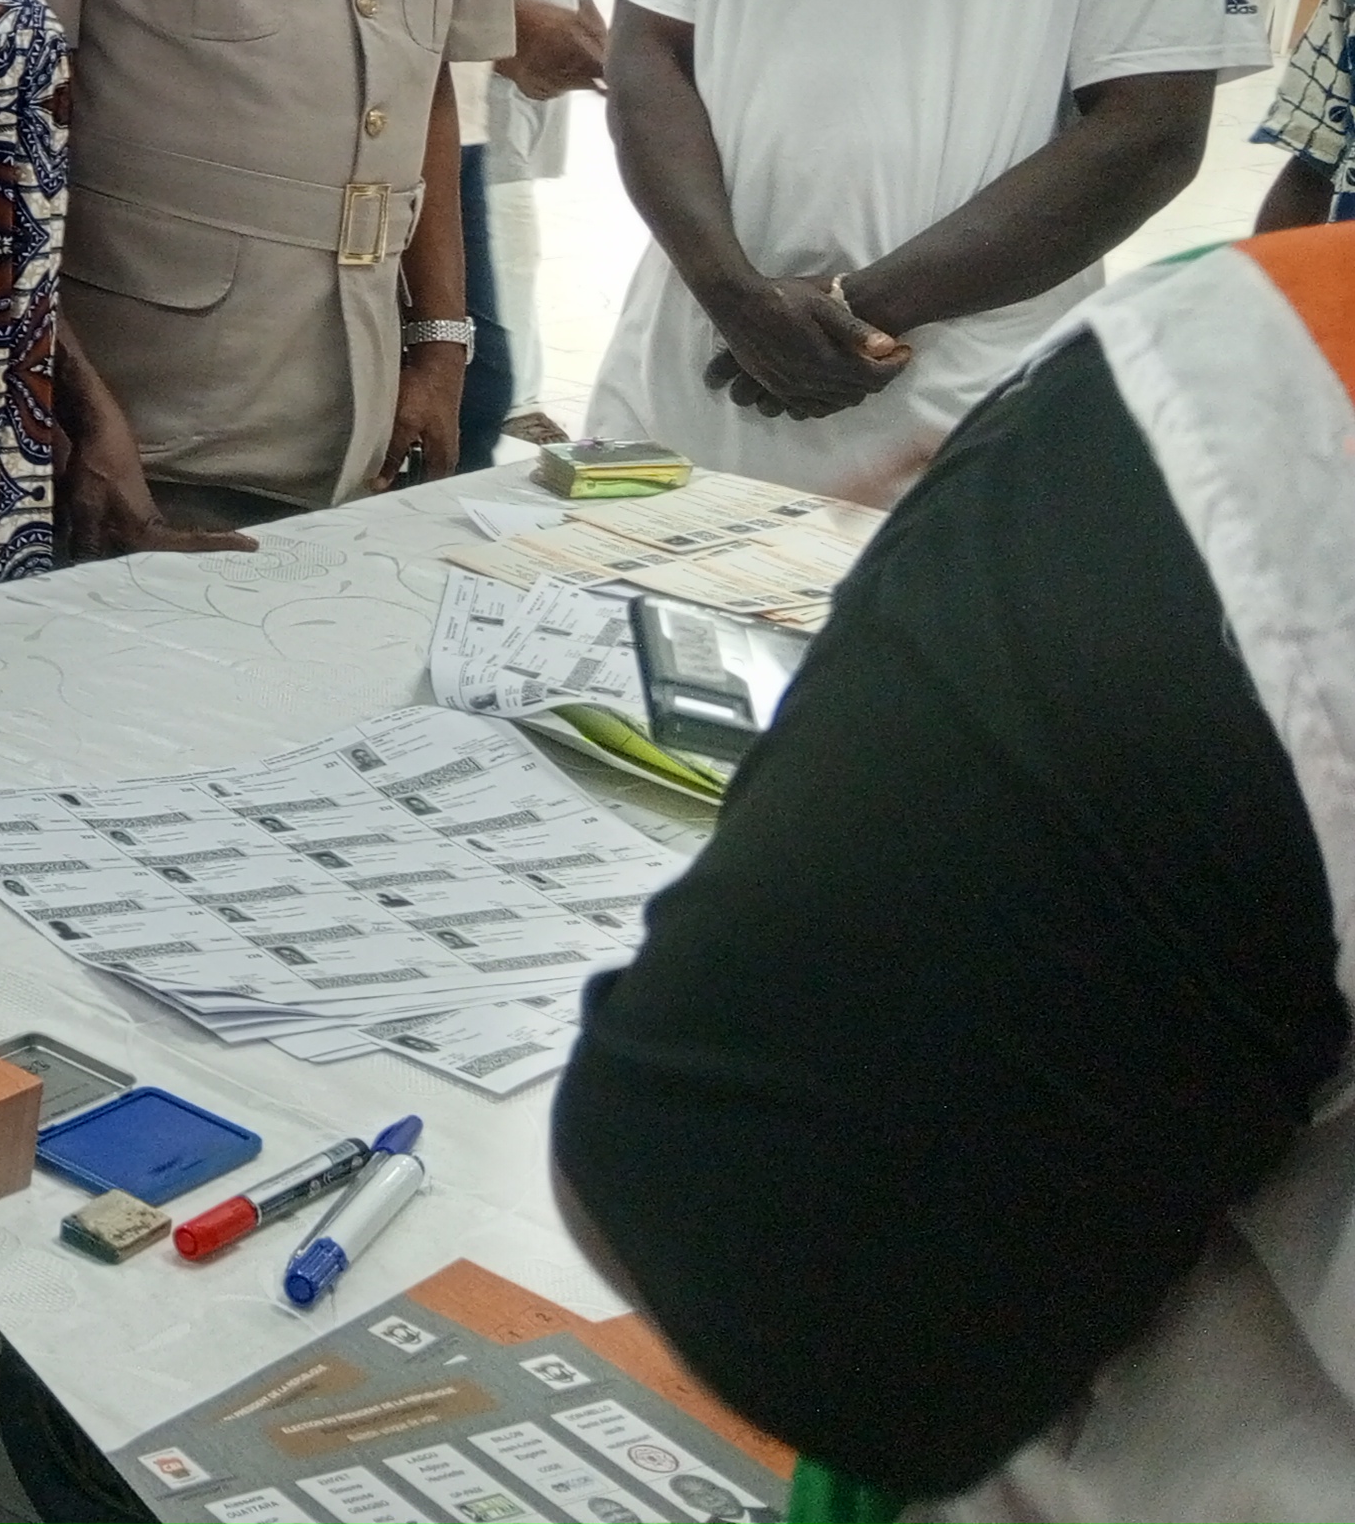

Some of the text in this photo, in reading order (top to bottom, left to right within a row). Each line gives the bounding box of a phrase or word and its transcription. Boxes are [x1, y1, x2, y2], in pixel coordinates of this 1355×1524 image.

[490, 1430, 525, 1444] BILLON
[405, 1451, 439, 1465] LAGOU
[537, 1463, 563, 1474] CODE
[226, 1501, 280, 1519] OUATTARA
